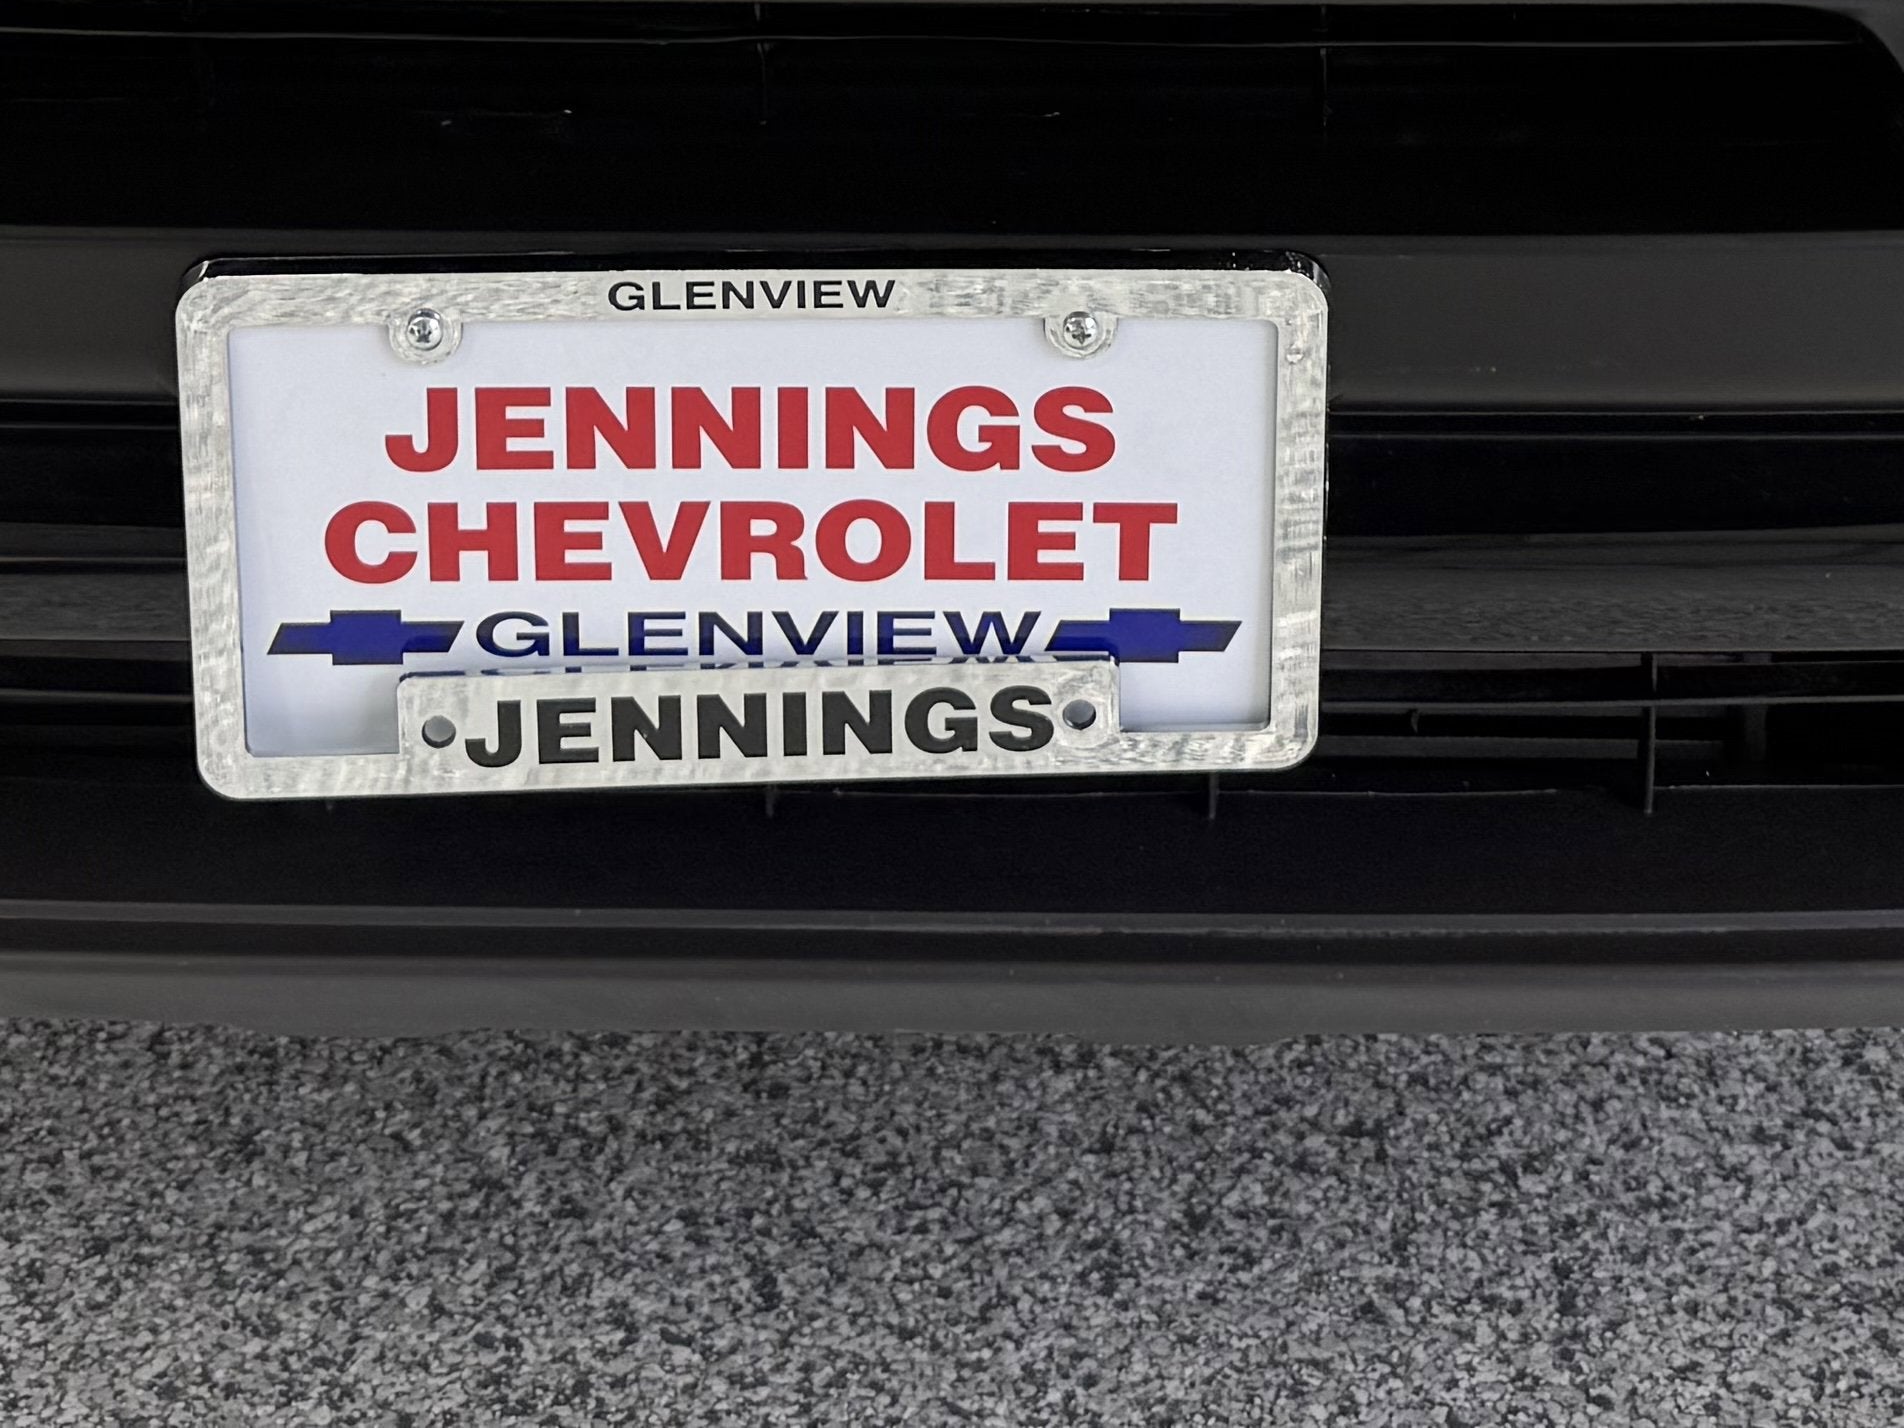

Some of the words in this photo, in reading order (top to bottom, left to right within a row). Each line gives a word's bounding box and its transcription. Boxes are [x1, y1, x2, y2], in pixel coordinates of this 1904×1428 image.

[606, 278, 898, 312] GLENVIEW
[384, 385, 1118, 473] JENNINGS
[323, 499, 1179, 584] CHEVROLET
[475, 610, 1042, 658] GLENVIEW
[464, 684, 1055, 769] JENNINGS
